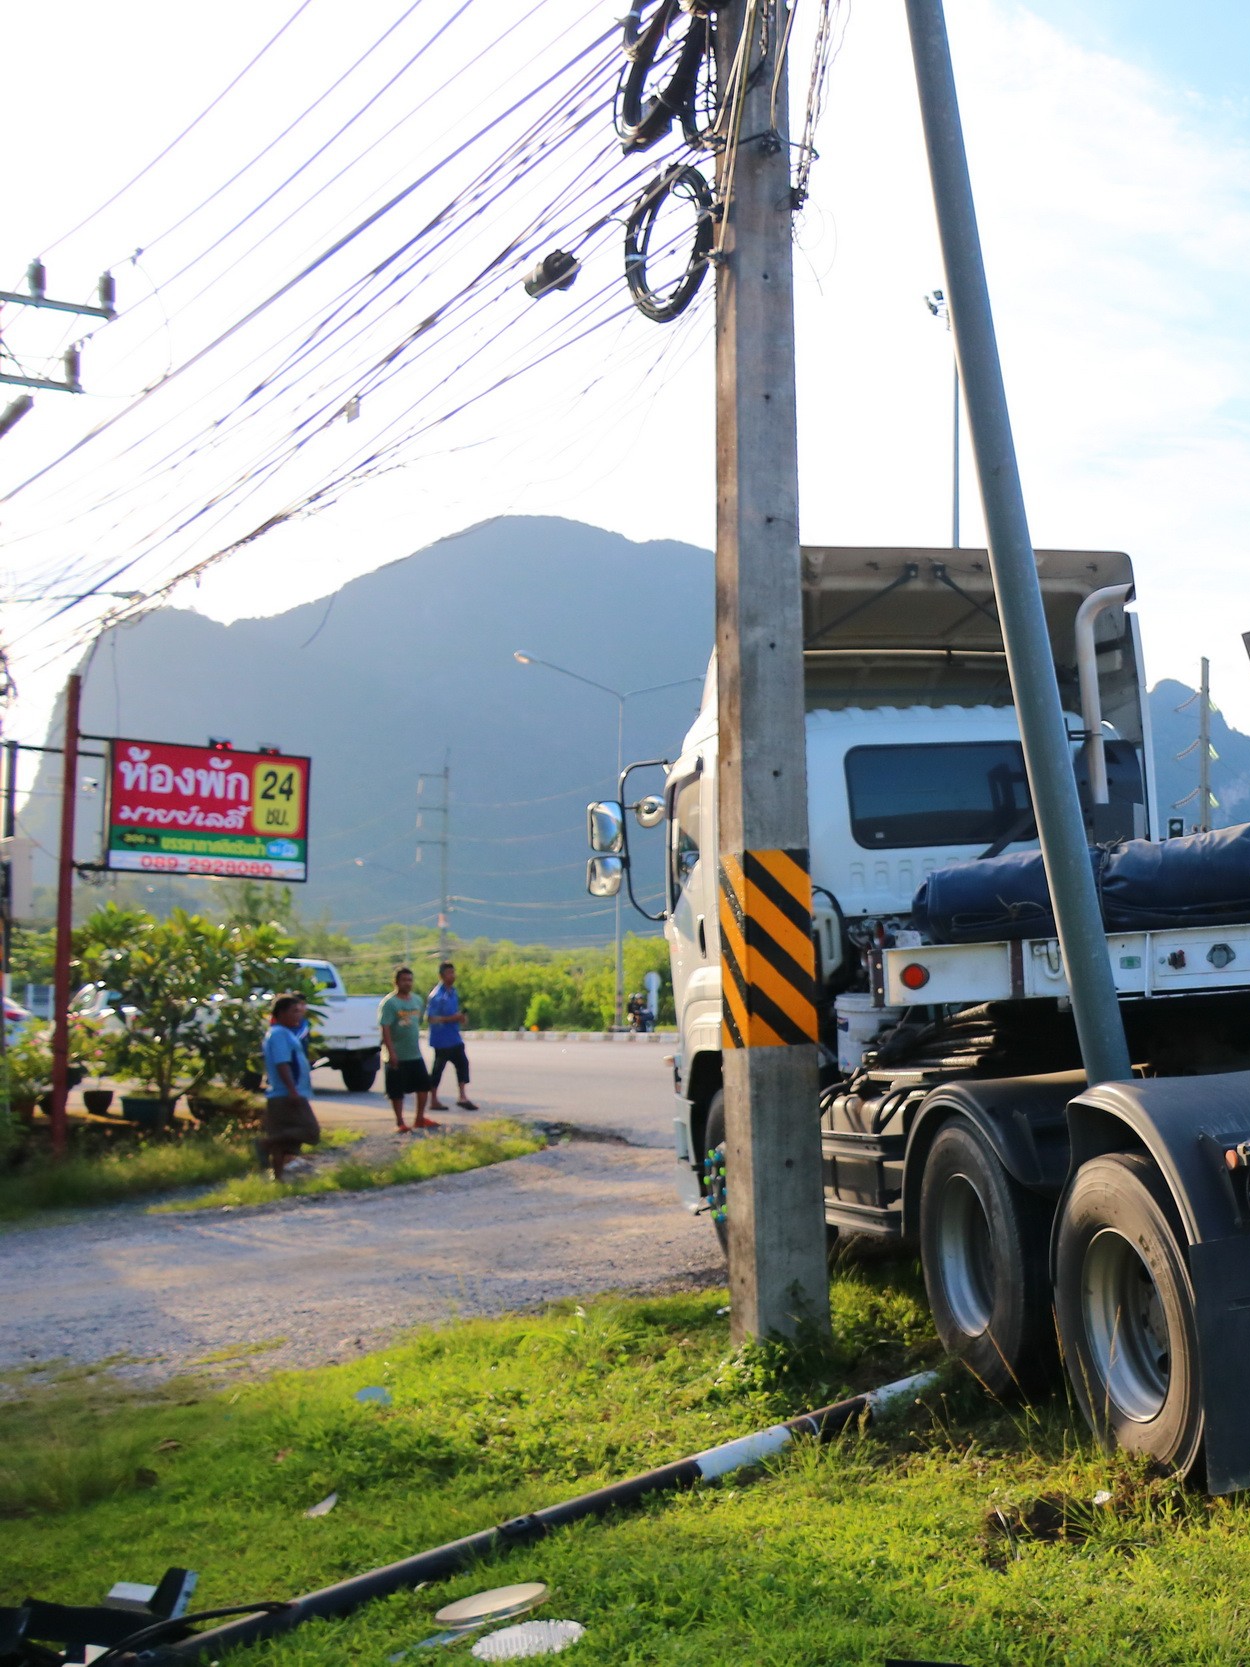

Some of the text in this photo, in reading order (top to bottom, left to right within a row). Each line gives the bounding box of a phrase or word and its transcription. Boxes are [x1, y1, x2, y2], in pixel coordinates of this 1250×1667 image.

[119, 746, 250, 801] ห้องพัก
[261, 770, 294, 801] 24
